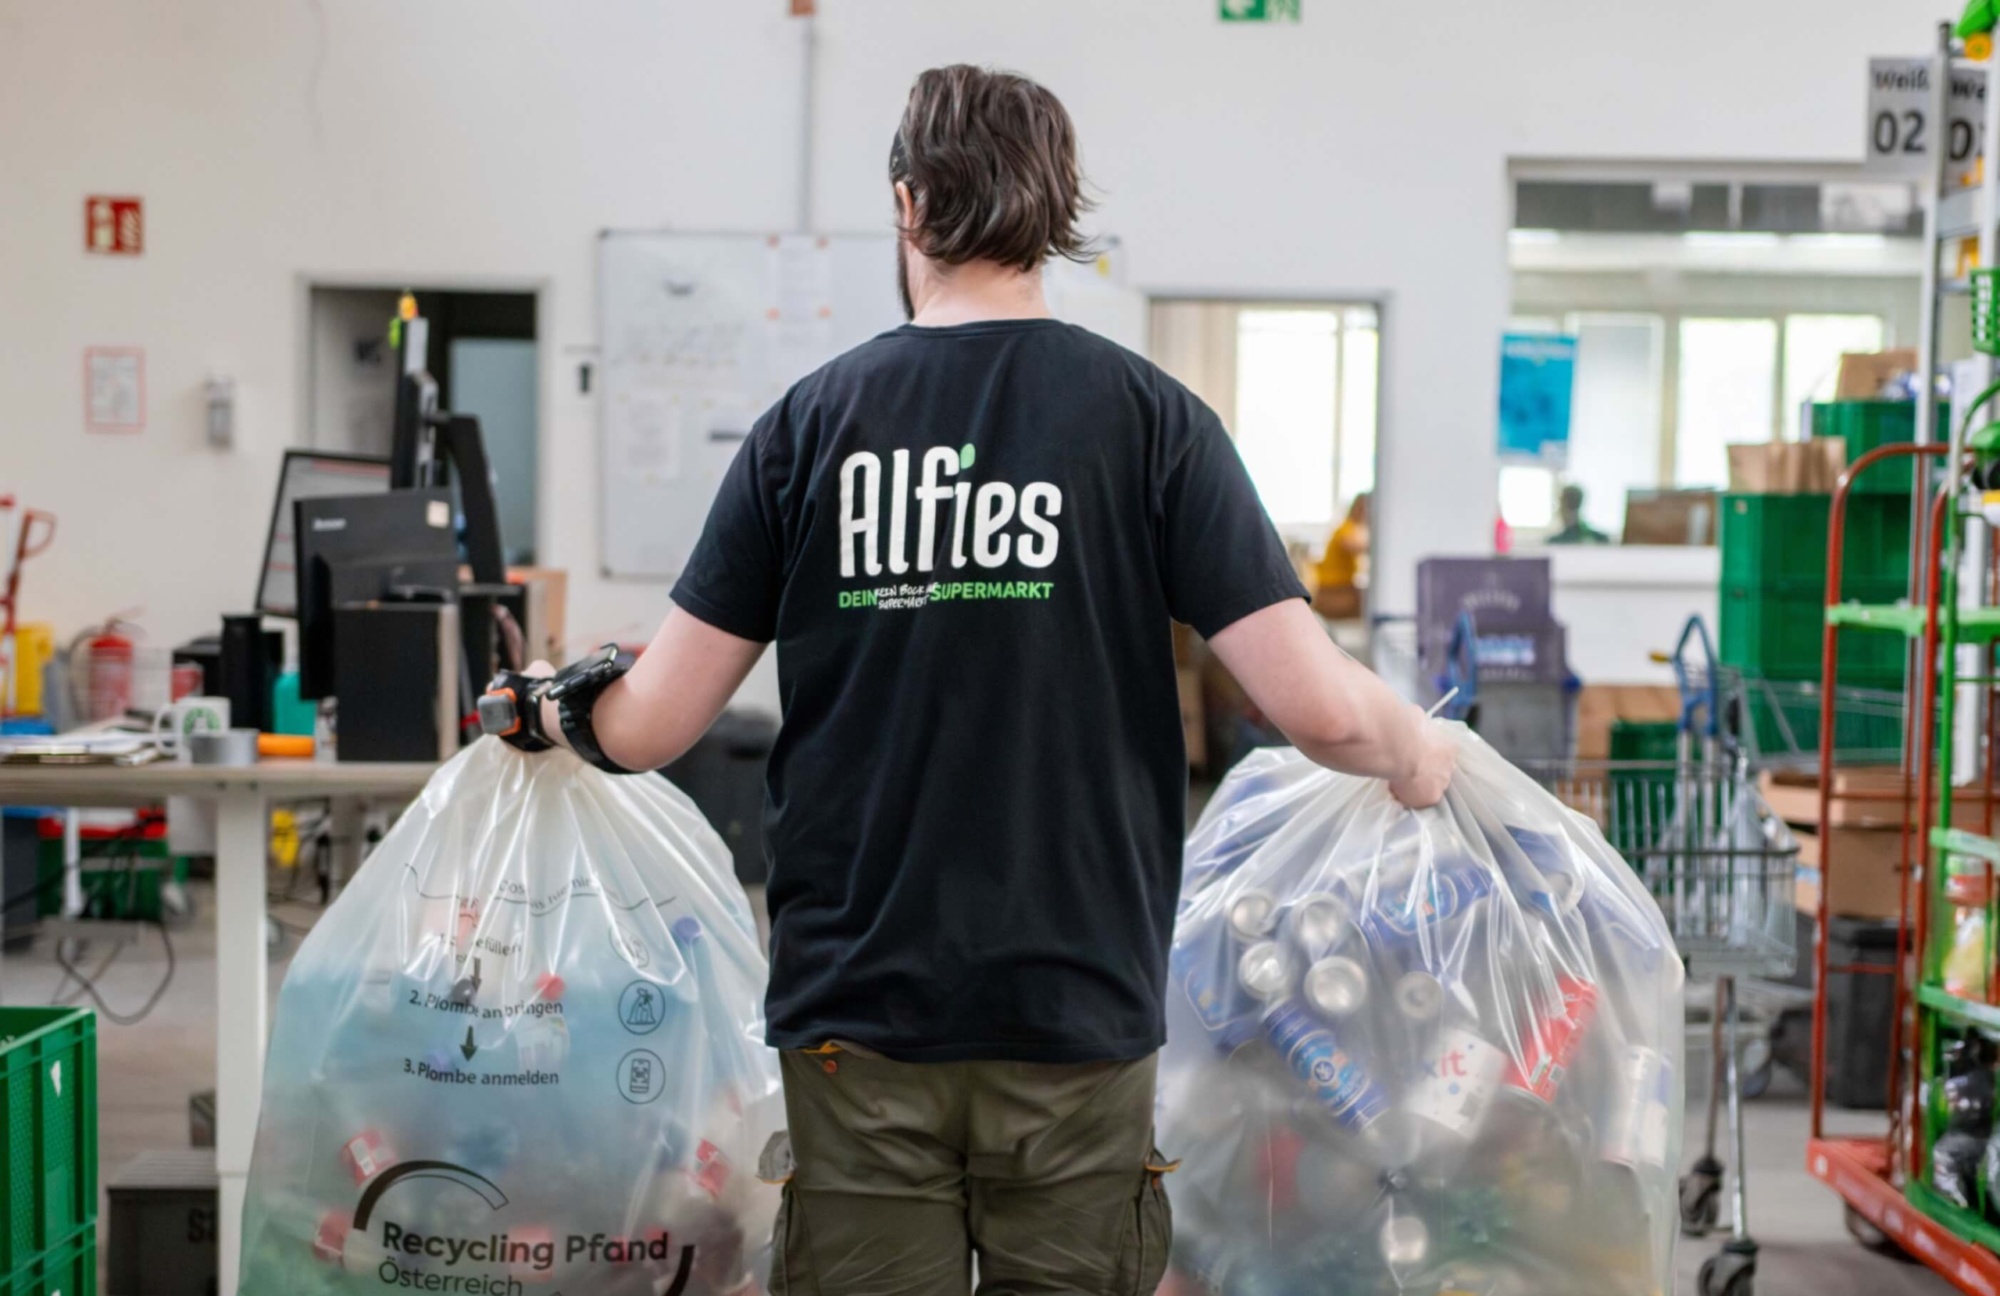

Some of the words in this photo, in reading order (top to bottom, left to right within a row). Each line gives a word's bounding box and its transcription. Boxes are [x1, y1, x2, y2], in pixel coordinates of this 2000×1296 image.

[1874, 109, 1926, 154] 02
[1949, 117, 1985, 160] 0
[839, 442, 1062, 577] Alfies
[838, 590, 877, 609] DEIN
[930, 582, 1053, 600] SUPERMARKT
[475, 936, 521, 957] efüllen
[409, 990, 421, 1007] 2.
[425, 993, 479, 1017] Plombe
[403, 1058, 415, 1074] 3.
[418, 1062, 476, 1085] Plombe
[481, 1070, 559, 1085] anmelden
[382, 1221, 554, 1270] Recycling
[566, 1231, 669, 1263] Pfand
[378, 1255, 523, 1296] Österreich
